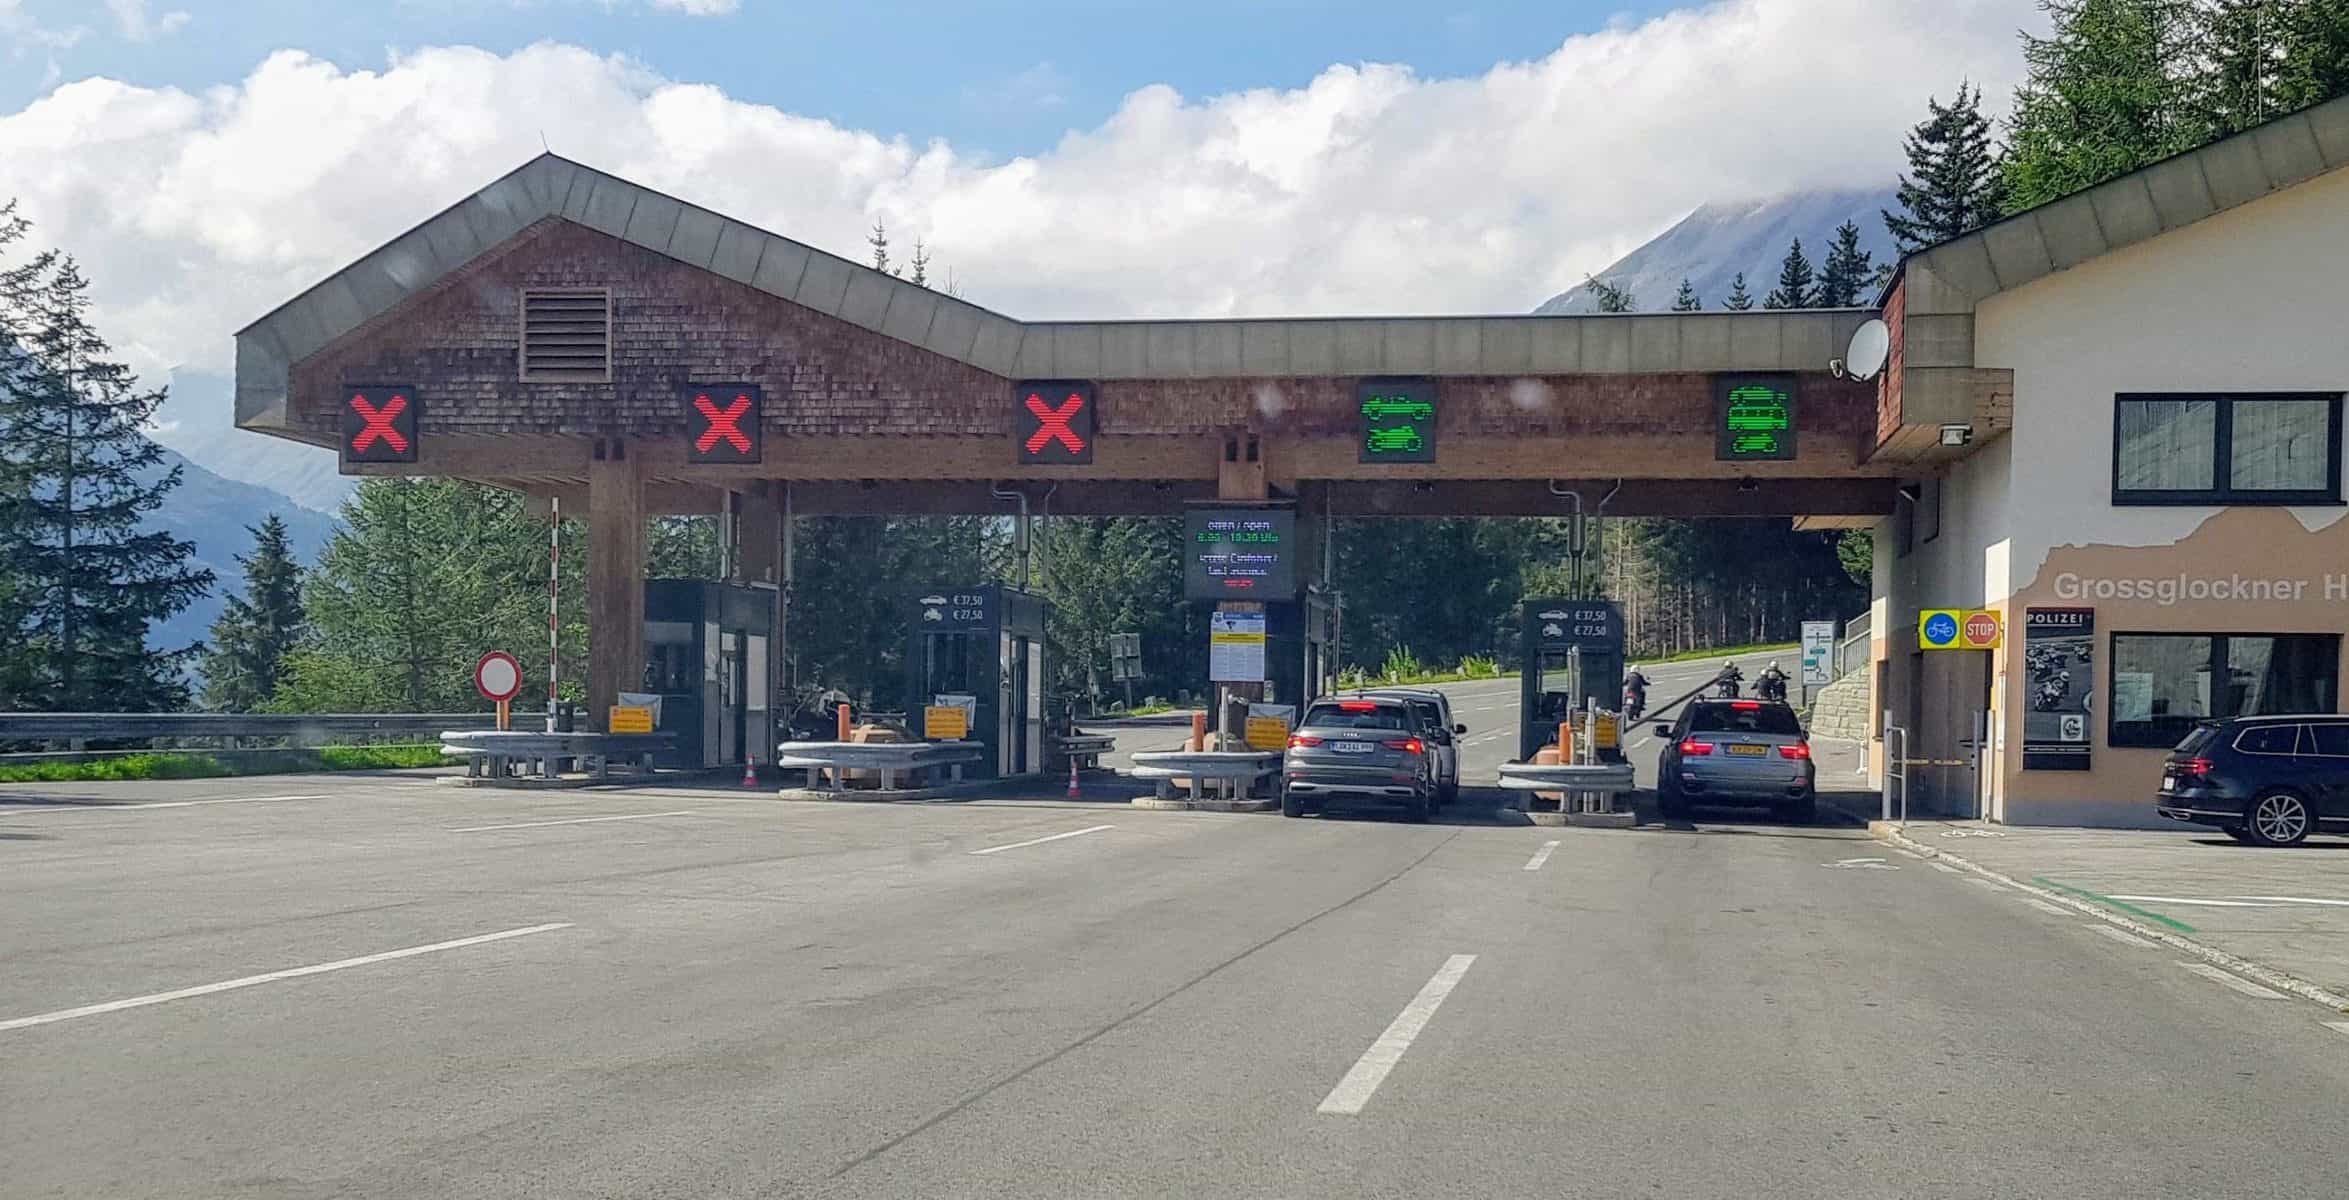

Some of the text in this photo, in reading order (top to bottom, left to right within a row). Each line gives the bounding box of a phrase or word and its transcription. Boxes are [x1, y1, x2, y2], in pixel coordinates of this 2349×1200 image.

[2054, 572, 2347, 606] Grossglockner H
[1584, 611, 1607, 622] 37,50
[2027, 614, 2083, 623] POLIZEI
[1583, 626, 1607, 636] 27,50
[1967, 623, 1995, 636] STOP
